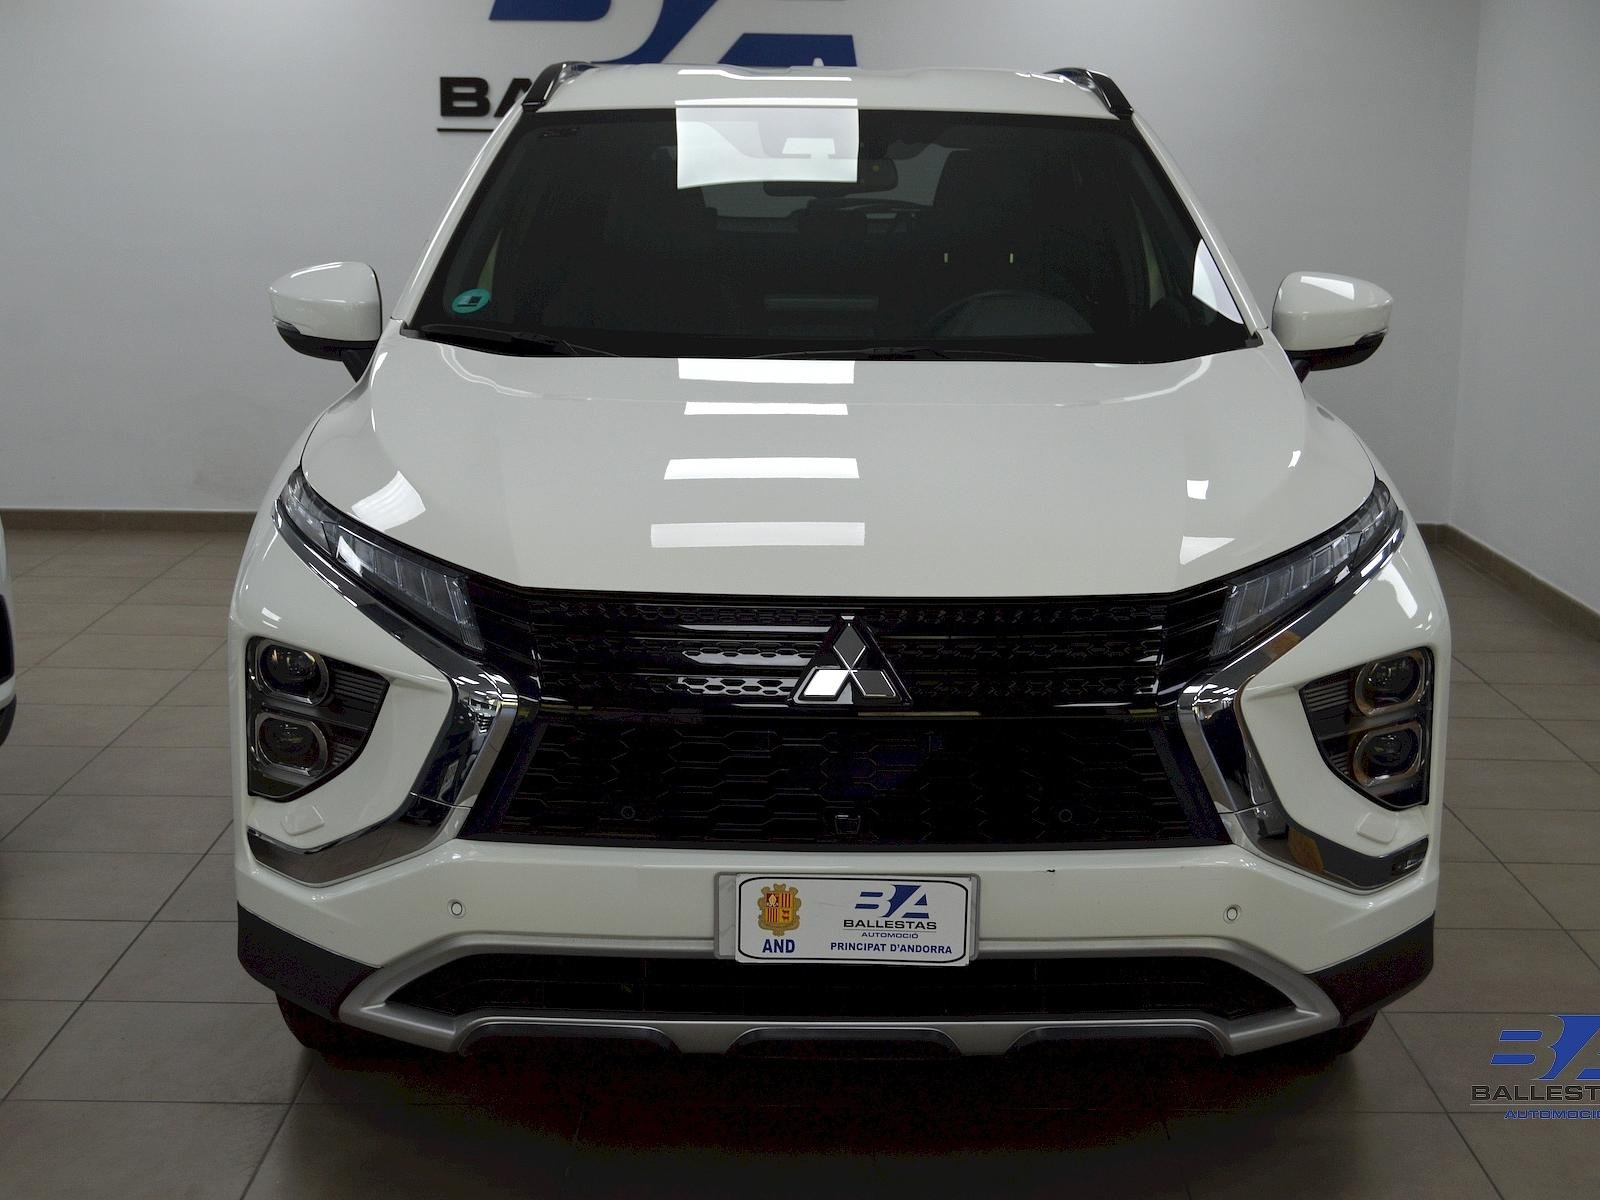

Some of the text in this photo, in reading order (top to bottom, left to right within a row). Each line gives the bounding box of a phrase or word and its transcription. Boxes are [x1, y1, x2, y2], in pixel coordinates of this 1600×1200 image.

[843, 919, 937, 930] BALLESTAS
[762, 938, 795, 954] AND
[830, 942, 952, 955] PRINCIPAT D'ANDORRA
